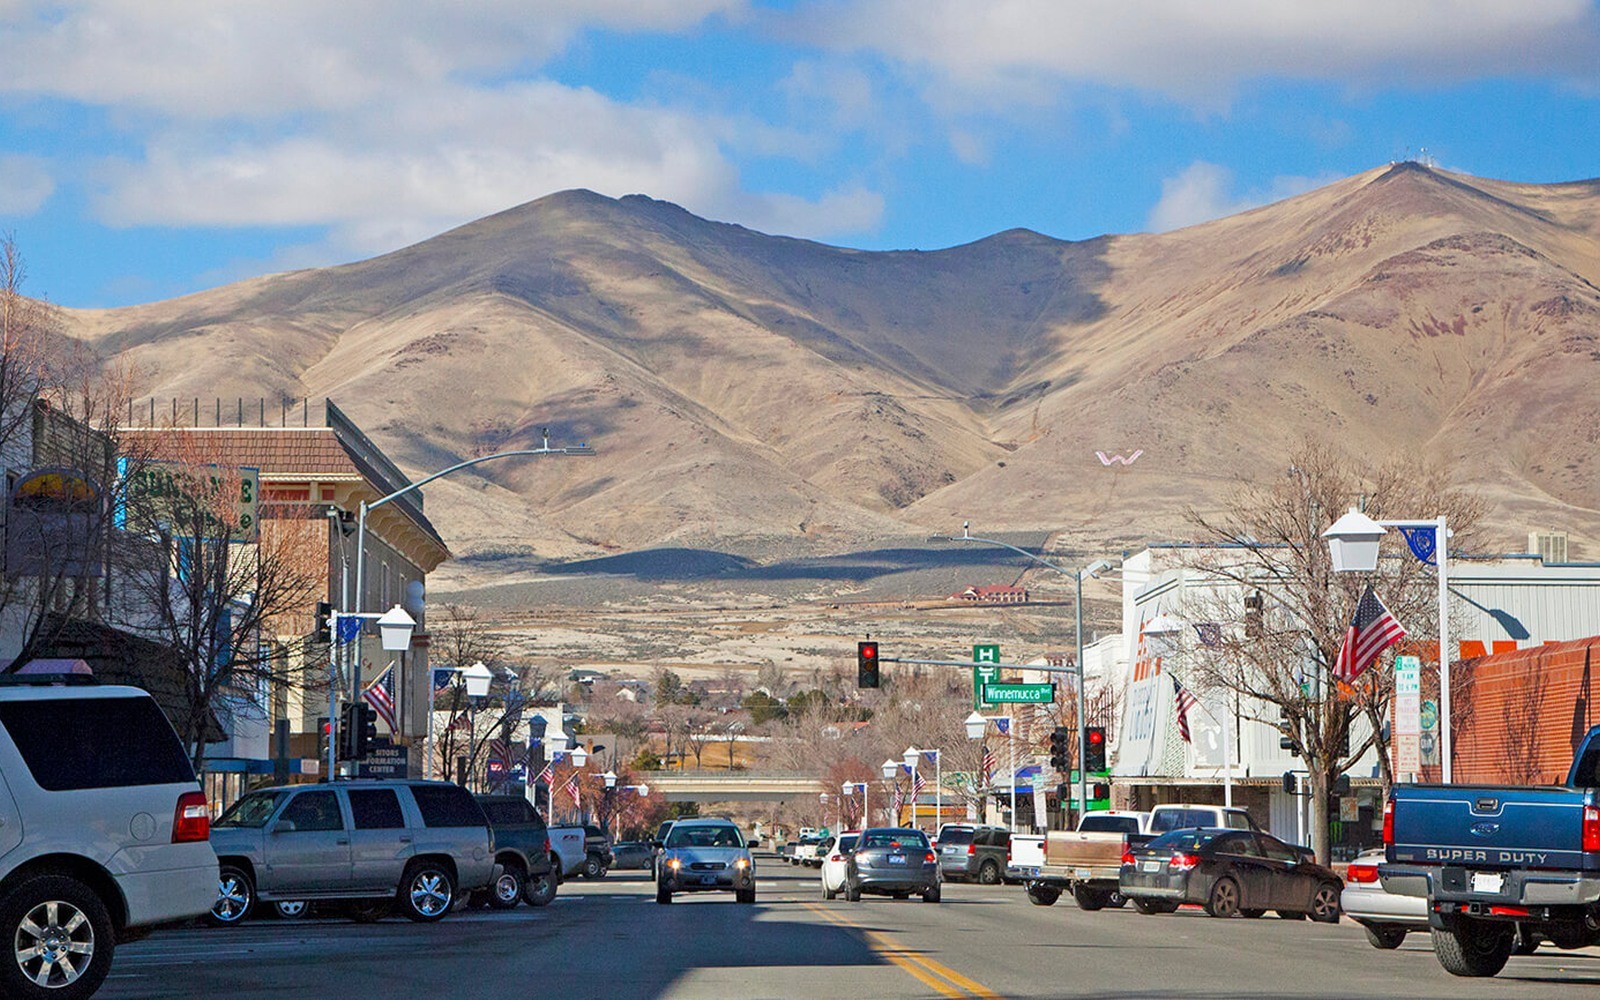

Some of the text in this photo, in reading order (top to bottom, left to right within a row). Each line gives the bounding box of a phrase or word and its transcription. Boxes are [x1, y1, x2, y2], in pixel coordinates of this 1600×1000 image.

[978, 648, 994, 708] HOTL
[987, 687, 1040, 700] Winnemucca
[1426, 848, 1547, 864] SUPER DUTY
